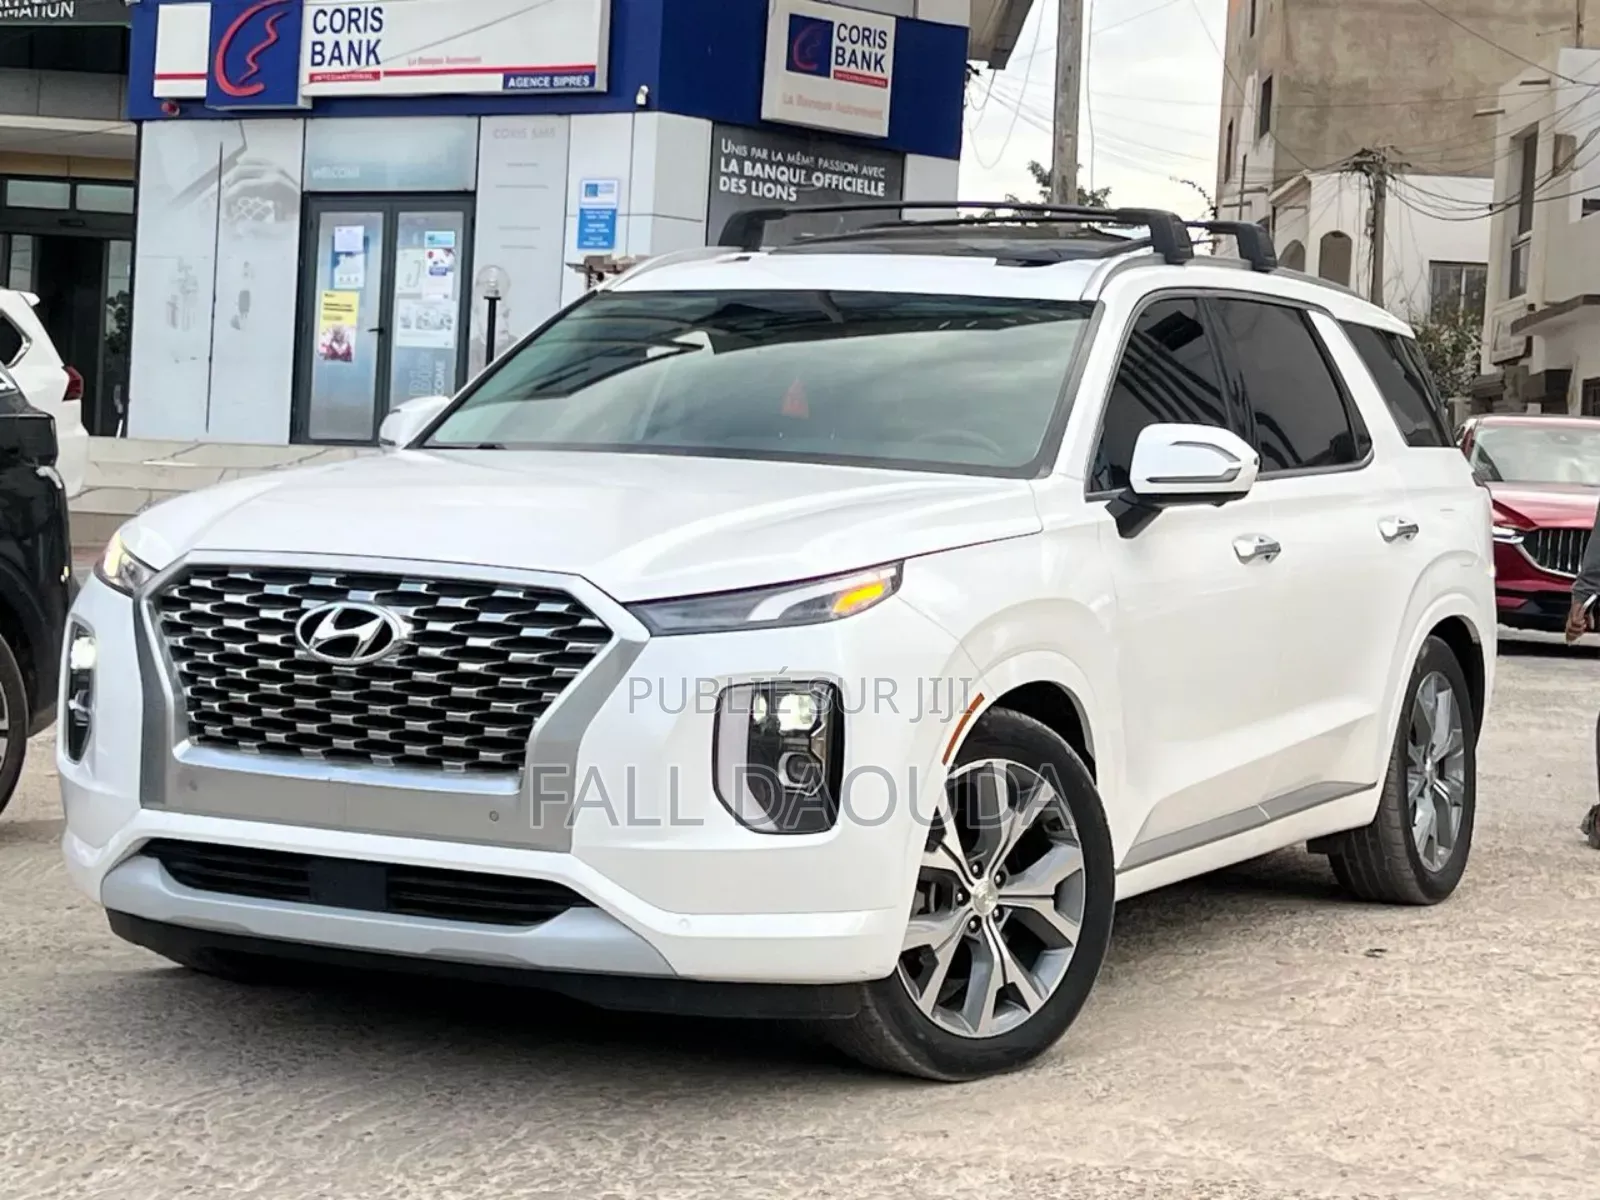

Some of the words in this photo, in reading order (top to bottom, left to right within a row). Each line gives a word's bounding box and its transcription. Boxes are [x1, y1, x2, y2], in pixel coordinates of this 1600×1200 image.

[313, 7, 383, 34] CORIS
[836, 23, 888, 50] CORIS
[310, 40, 381, 66] BANK
[834, 46, 885, 73] BANK
[508, 76, 550, 88] AGENCE
[553, 75, 590, 87] SIPRES
[750, 147, 768, 160] PAR
[771, 150, 784, 162] LA
[818, 157, 859, 174] PASSION
[861, 164, 886, 179] AVEC
[719, 176, 747, 194] DES
[751, 181, 797, 202] LIONS
[720, 157, 739, 174] LA
[744, 162, 808, 185] BANQUE
[811, 172, 886, 197] OFFICIELLE
